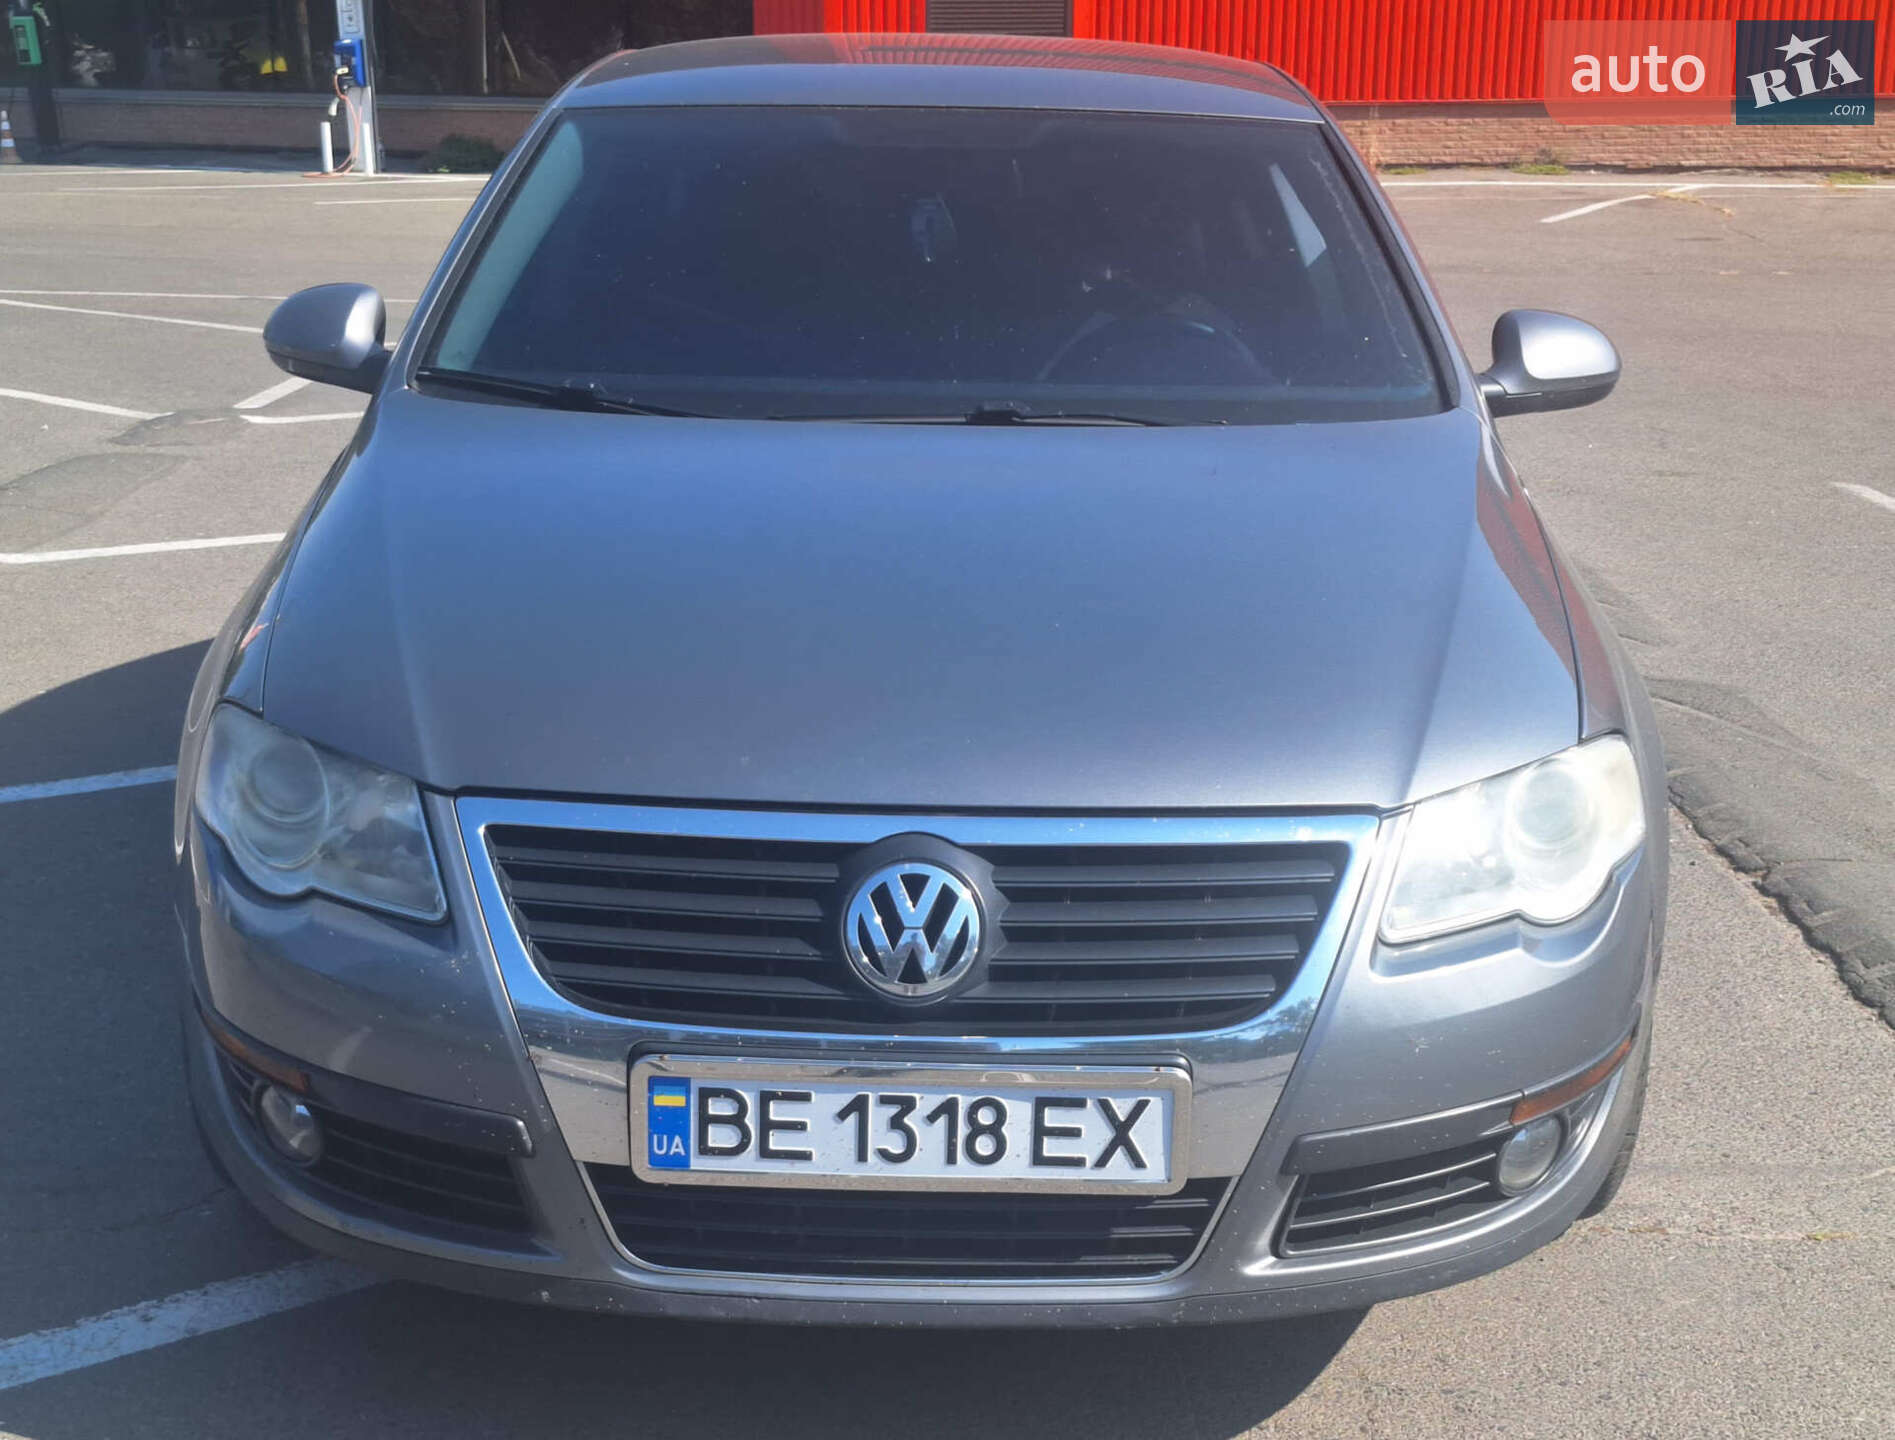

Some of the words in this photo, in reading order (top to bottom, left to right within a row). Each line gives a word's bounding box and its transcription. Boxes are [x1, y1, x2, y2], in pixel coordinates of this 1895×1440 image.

[653, 1133, 686, 1156] UA
[699, 1087, 814, 1161] BE
[837, 1093, 1008, 1165] 1318
[1032, 1096, 1152, 1169] EX
